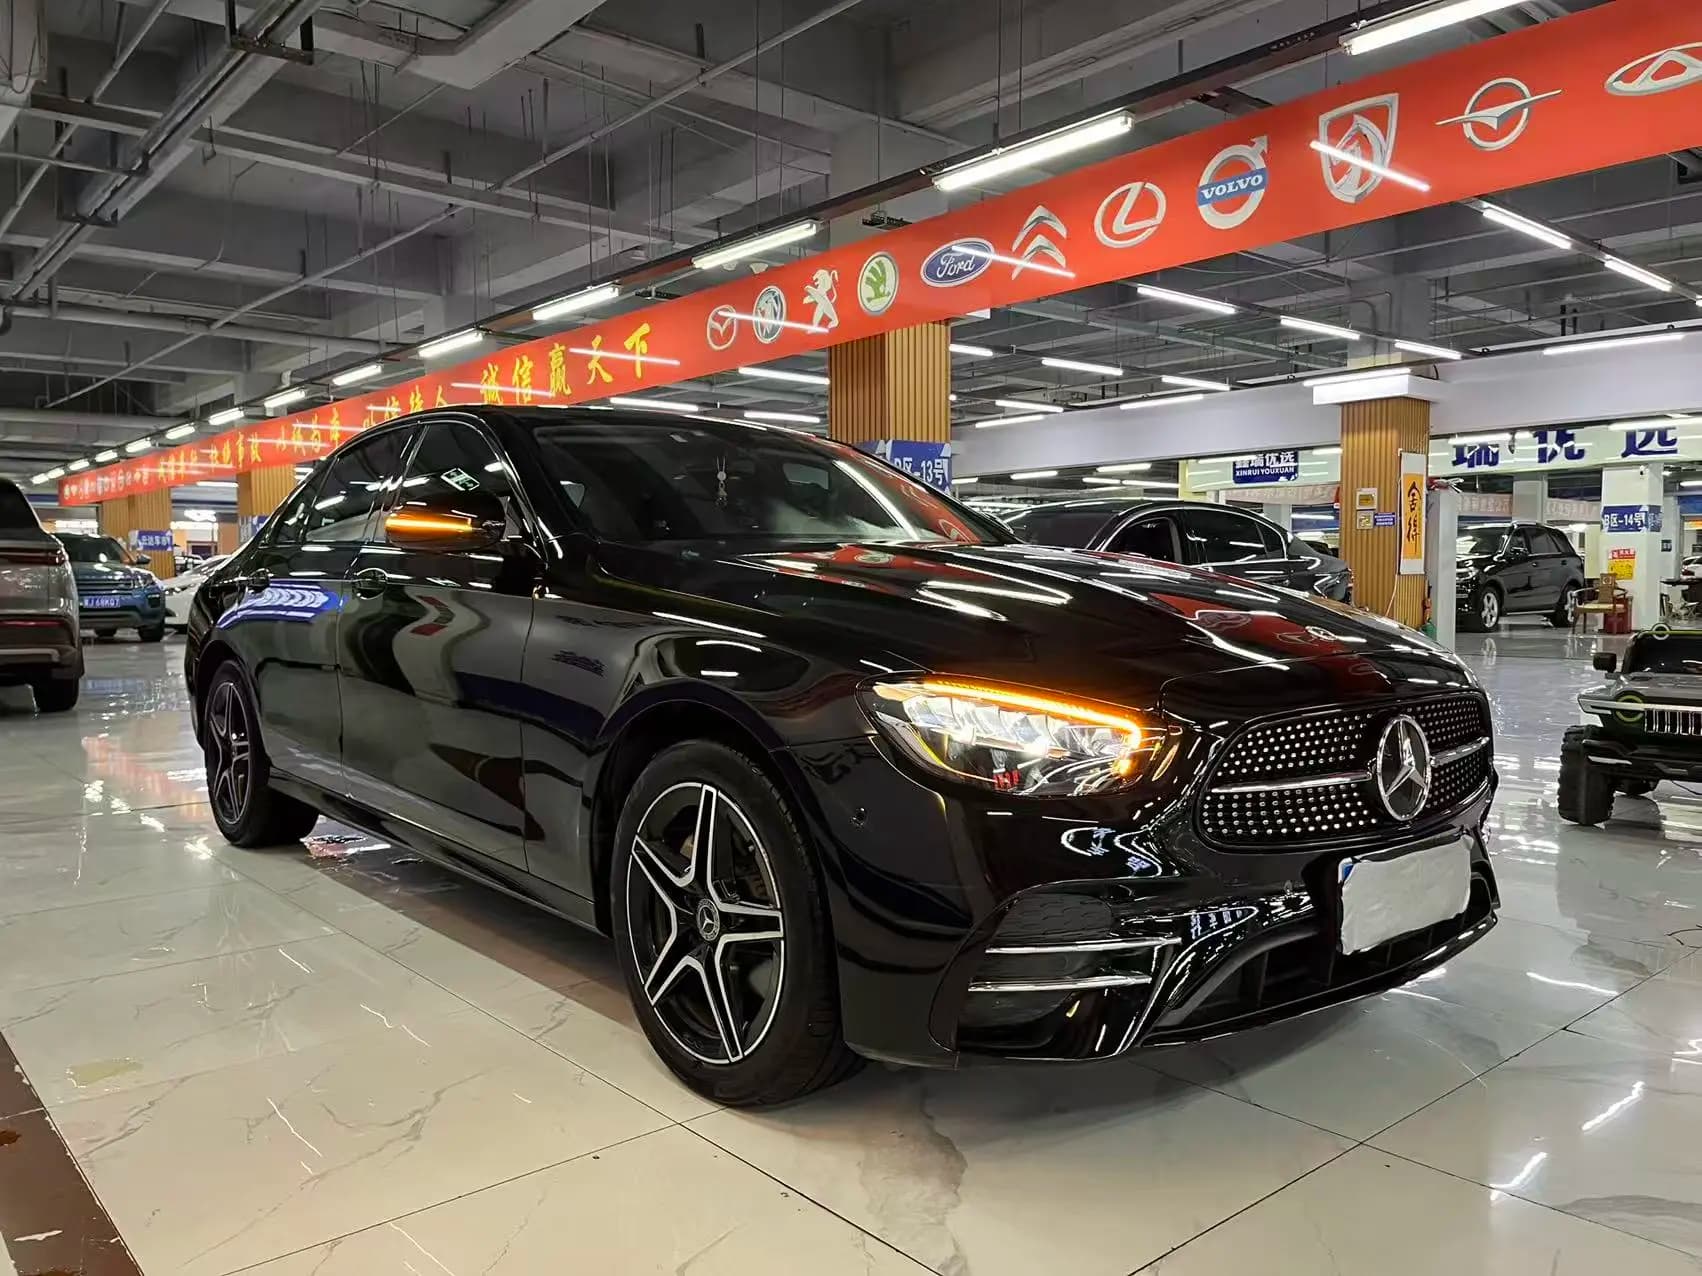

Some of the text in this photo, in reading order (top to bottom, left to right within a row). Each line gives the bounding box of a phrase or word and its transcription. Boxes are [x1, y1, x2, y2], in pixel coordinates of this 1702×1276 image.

[1201, 174, 1263, 200] VOLVO
[936, 251, 976, 278] Ford
[479, 322, 651, 405] 诚信赢天下
[1235, 466, 1295, 476] XINRUI YOUXUAN
[1604, 512, 1643, 527] B区-14号
